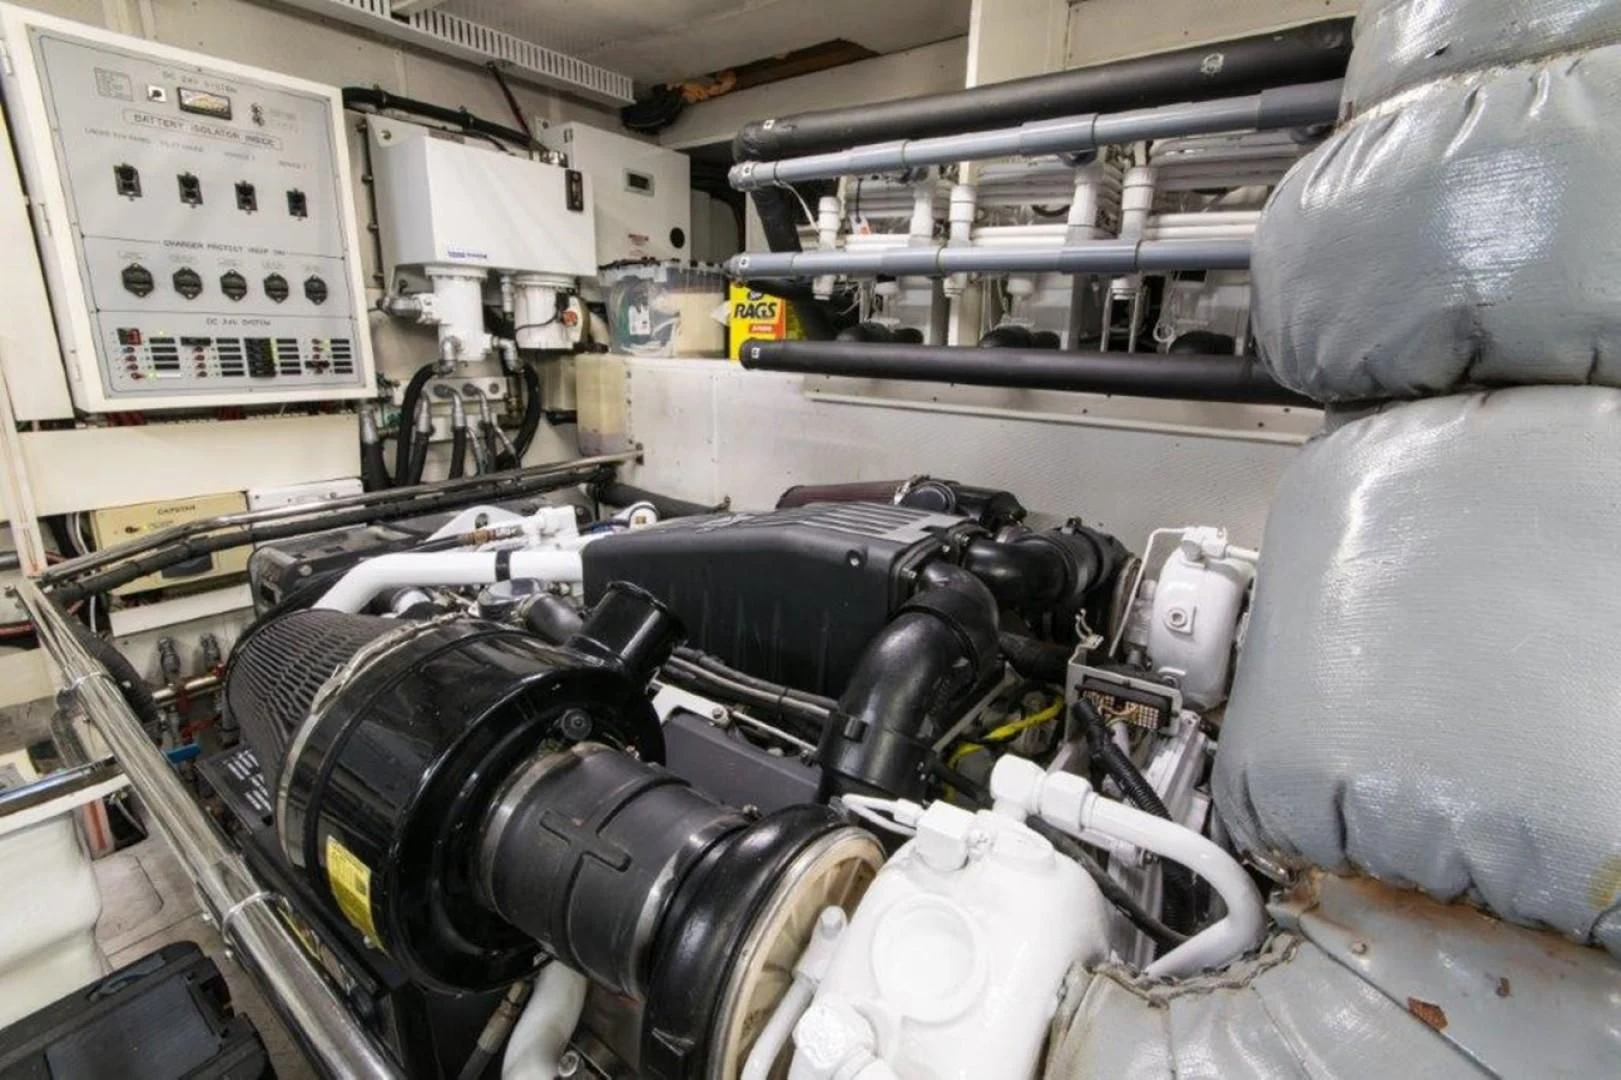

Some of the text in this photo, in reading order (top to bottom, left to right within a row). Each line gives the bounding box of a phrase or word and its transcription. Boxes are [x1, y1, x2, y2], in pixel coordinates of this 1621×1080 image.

[133, 112, 184, 130] BATTERY
[190, 123, 242, 142] ISOLATOR
[734, 303, 777, 318] RAGS
[157, 504, 196, 515] CAPSTAN
